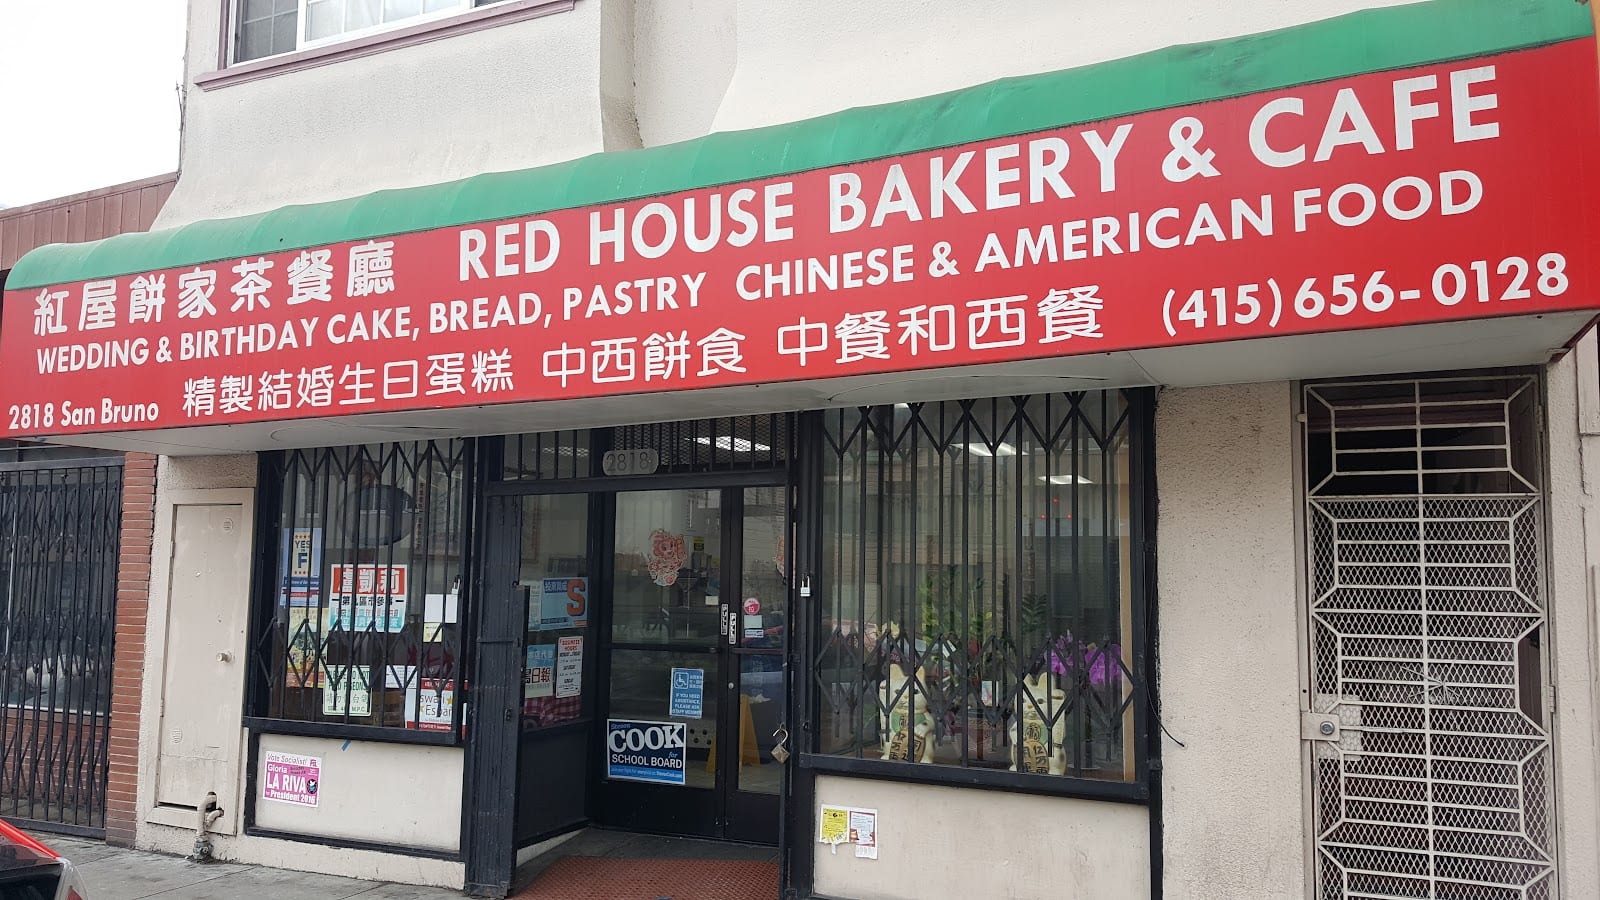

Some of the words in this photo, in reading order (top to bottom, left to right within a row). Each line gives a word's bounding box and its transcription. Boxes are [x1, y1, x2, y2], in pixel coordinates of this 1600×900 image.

[460, 222, 561, 282] RED
[590, 182, 794, 266] HOUSE
[829, 124, 1133, 234] BAKERY
[1162, 116, 1221, 183] &
[1249, 66, 1500, 168] CAFE
[736, 245, 915, 303] CHINESE
[929, 241, 960, 278] &
[975, 194, 1274, 273] AMERICAN
[1294, 170, 1483, 233] FOOD
[34, 239, 396, 337] 紅屋餅家茶餐廳
[1163, 278, 1282, 338] (415)
[1294, 252, 1569, 319] 656-0128
[37, 338, 149, 374] WEDDING
[156, 336, 173, 364] &
[180, 315, 319, 361] BIRTHDAY
[327, 306, 420, 345] CAKE,
[430, 293, 551, 333] BREAD,
[564, 271, 707, 320] PASTRY
[183, 347, 513, 419] 精製結婚生日蛋糕
[543, 328, 747, 389] 中西餅食
[778, 285, 1104, 367] 中餐和西餐
[9, 404, 54, 430] 2818
[61, 401, 96, 427] San
[101, 398, 159, 424] Bruno
[607, 452, 649, 472] 2818
[298, 553, 308, 568] F
[567, 579, 586, 616] S
[608, 725, 684, 753] COOK
[267, 753, 280, 762] Vote
[267, 763, 287, 774] Gloria
[612, 754, 649, 766] SCHOOL
[651, 757, 683, 769] BOARD
[267, 772, 280, 790] LA
[282, 774, 307, 793] RIVA
[270, 790, 300, 801] President
